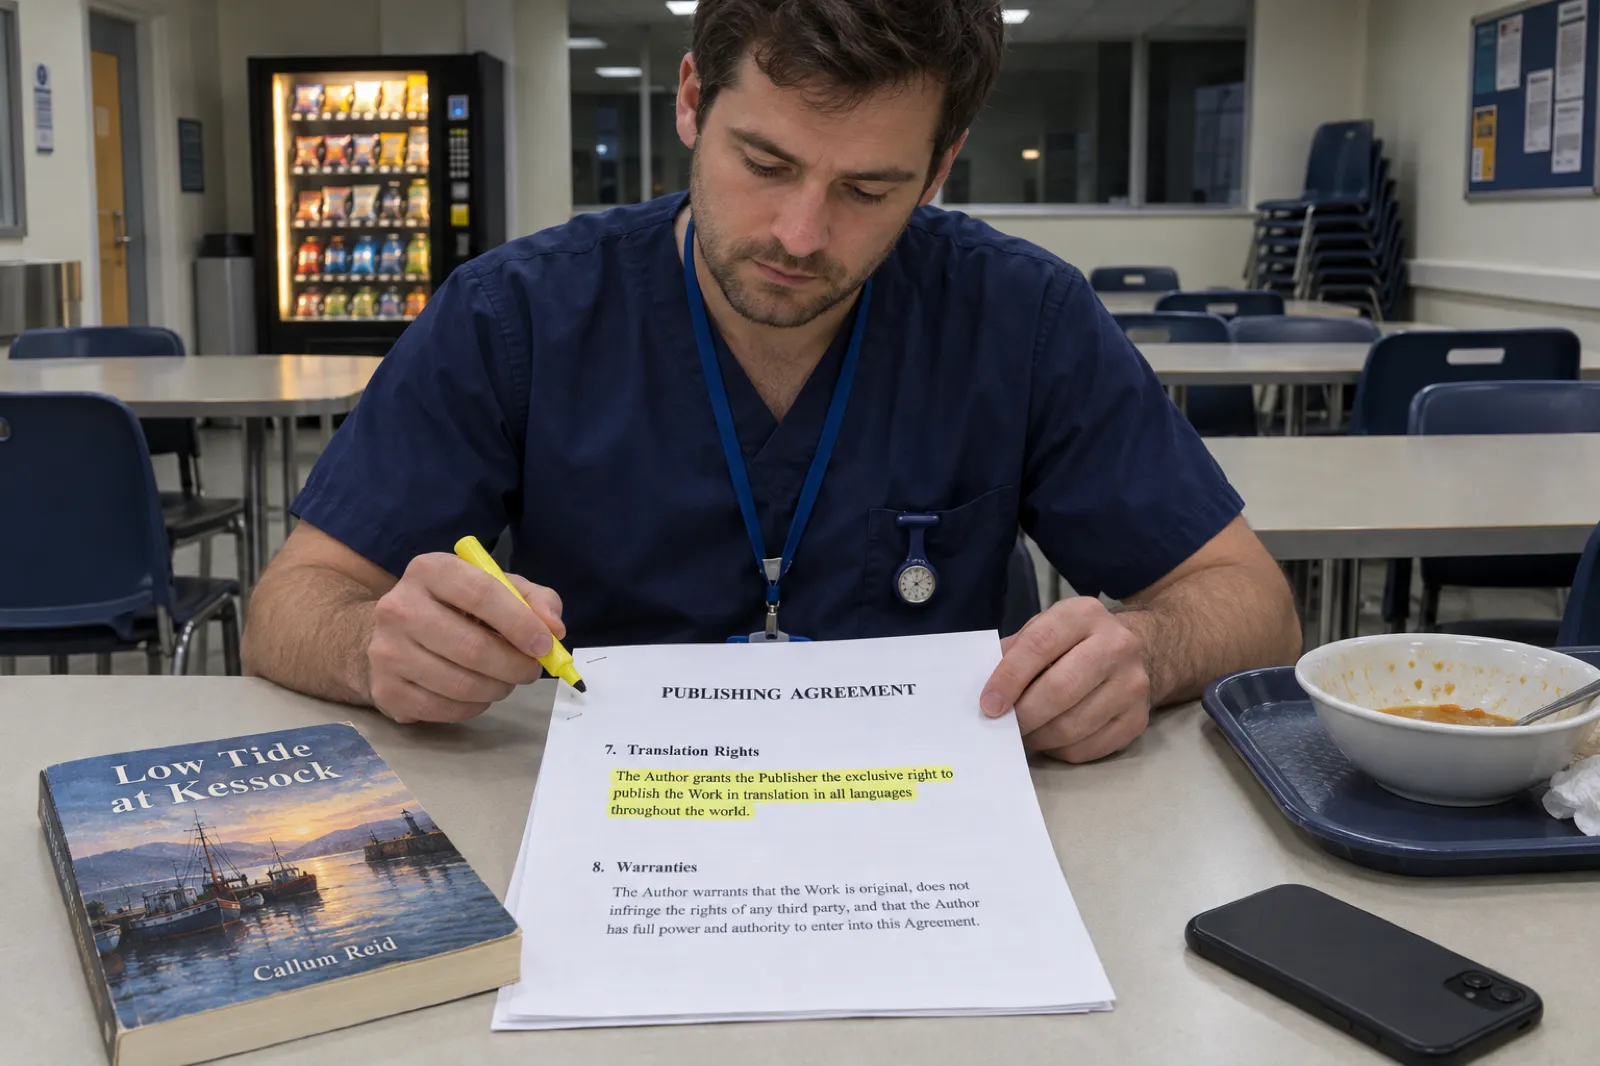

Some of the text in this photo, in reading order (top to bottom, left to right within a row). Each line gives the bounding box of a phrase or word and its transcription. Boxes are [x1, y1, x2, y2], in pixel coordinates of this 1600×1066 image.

[662, 683, 917, 701] PUBLISHING AGREEMENT
[604, 743, 760, 760] 7. Translation Rights
[111, 742, 313, 785] Low Tide
[616, 768, 954, 786] The Author grants the Publisher the exclusive right to
[111, 761, 342, 813] at Kessock
[612, 787, 913, 801] publish the Work in translation in all languages
[611, 804, 751, 818] throughout the world.
[592, 861, 698, 873] 8. Warranties
[612, 881, 970, 898] The Author warrants that the Work is original, does not
[609, 898, 980, 920] infringe the rights of any third party, and that the Author
[606, 916, 980, 937] has full power and authority to enter into this Agreement.
[253, 936, 398, 982] Callum Reid
